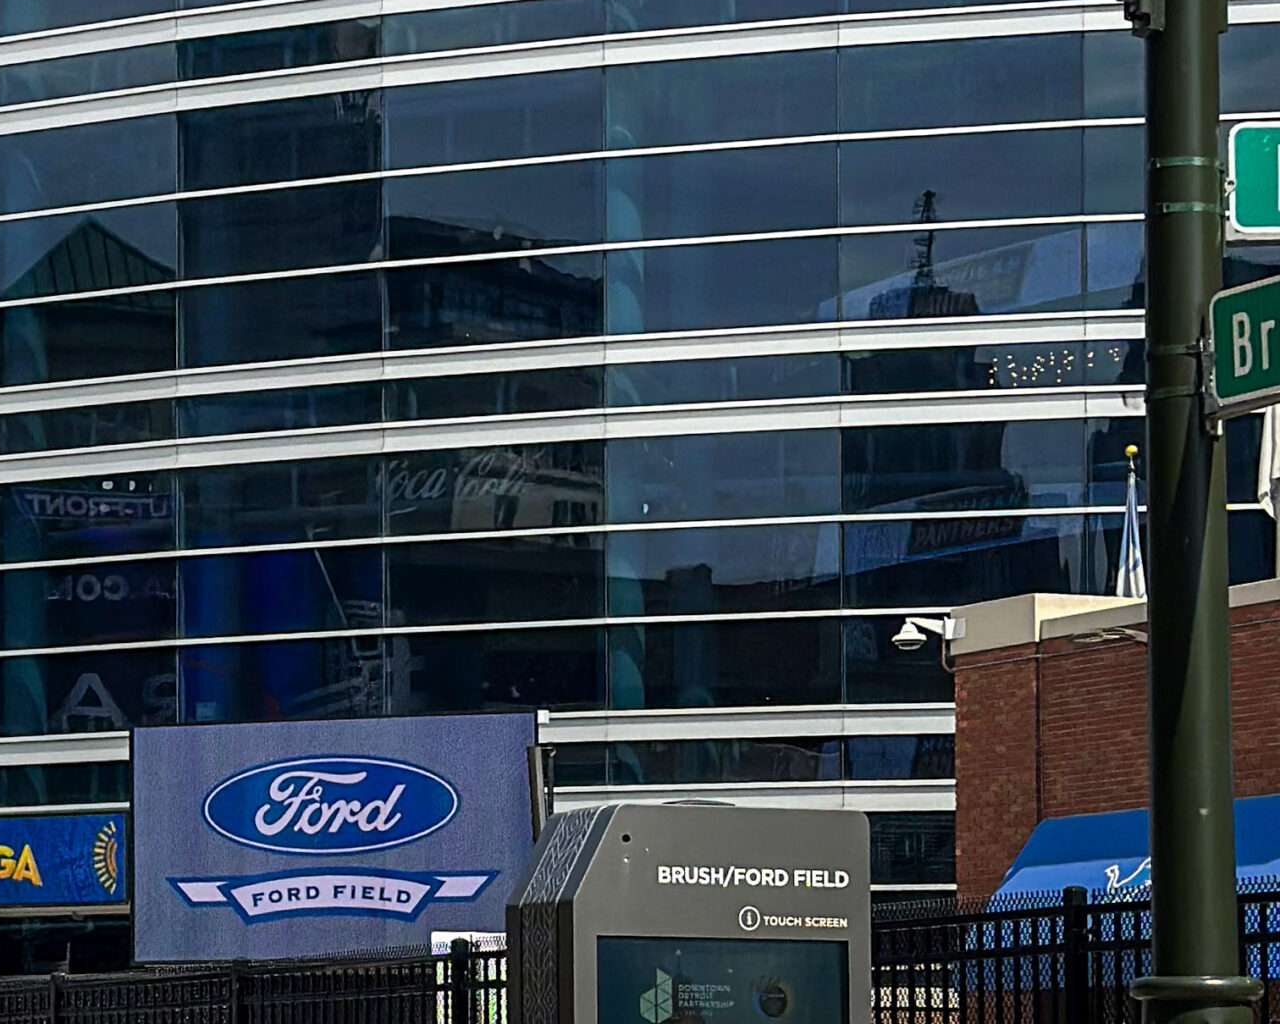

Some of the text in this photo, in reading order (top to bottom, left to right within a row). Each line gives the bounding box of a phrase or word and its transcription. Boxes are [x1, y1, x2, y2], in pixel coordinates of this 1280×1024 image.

[253, 770, 407, 836] Ford
[657, 865, 850, 888] BRUSH/FORD FIELD
[252, 883, 413, 907] FORD FIELD
[763, 915, 802, 927] TOUCH
[805, 917, 848, 928] SCREEN
